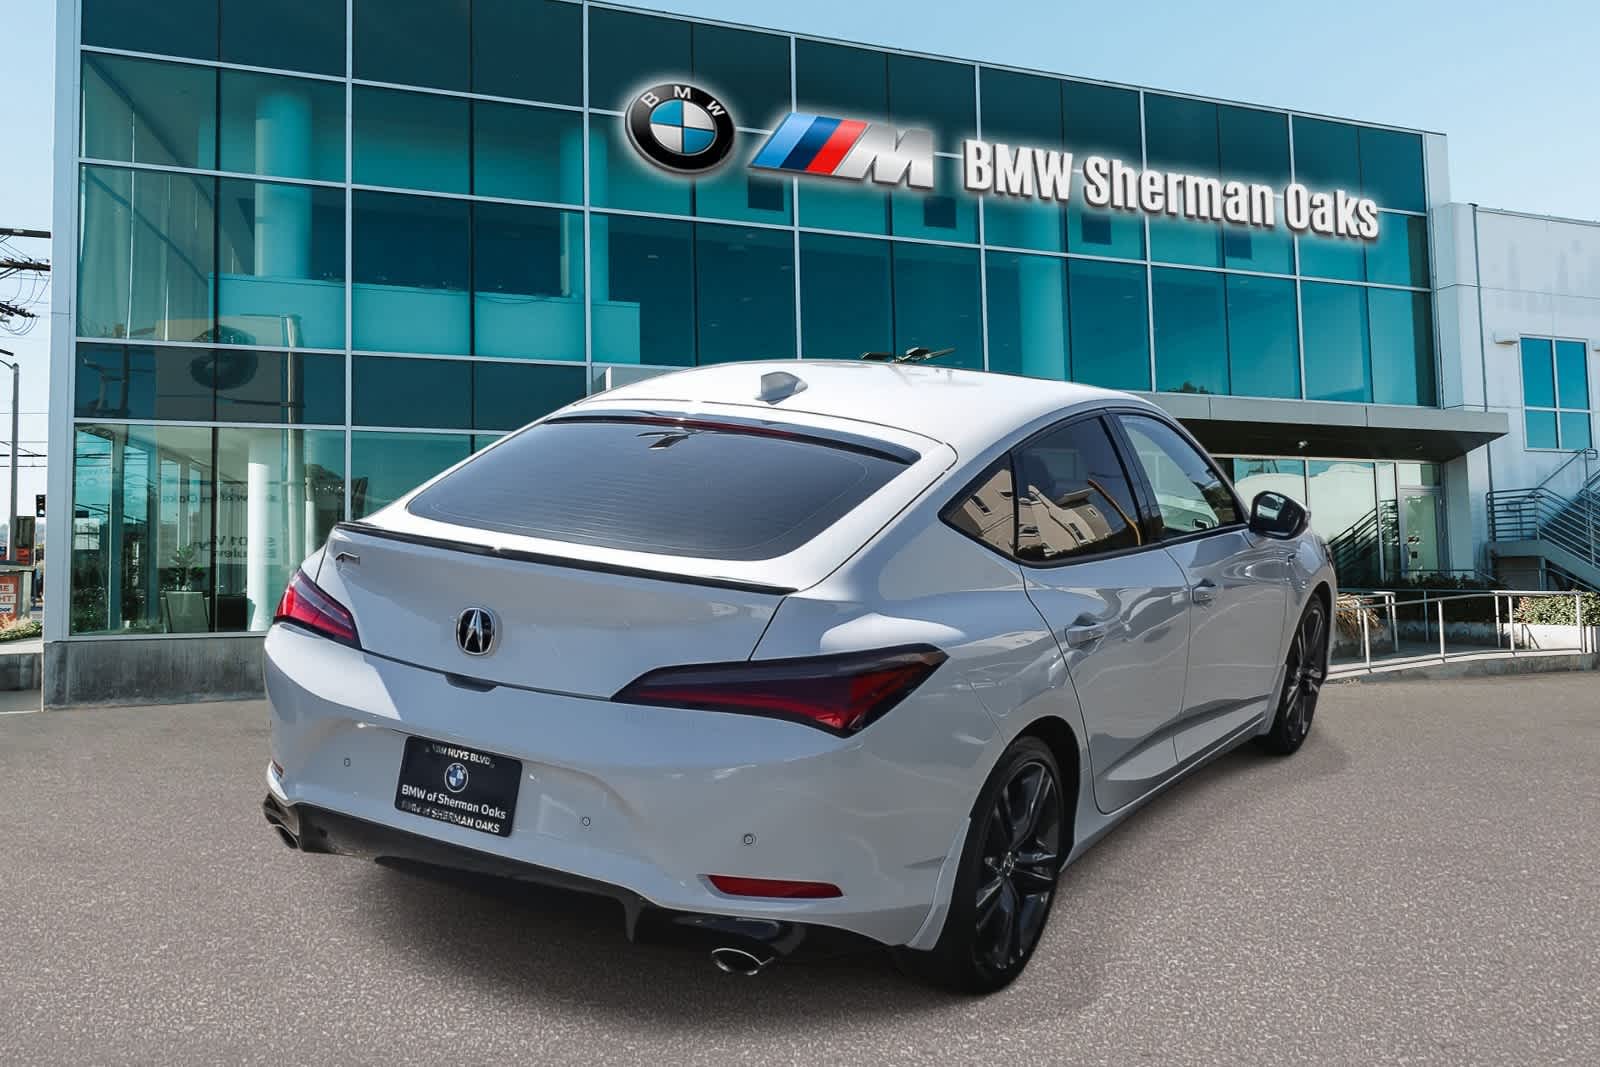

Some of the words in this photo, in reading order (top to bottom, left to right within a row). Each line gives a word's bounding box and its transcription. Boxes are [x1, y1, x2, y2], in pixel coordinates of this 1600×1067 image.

[641, 85, 725, 118] BMW
[963, 138, 1073, 204] BMW
[1083, 155, 1276, 228] Sherman
[1284, 183, 1379, 241] Oaks
[447, 747, 469, 760] NUYS
[470, 752, 492, 765] BLVD
[401, 784, 426, 800] BMW
[427, 792, 437, 802] of
[438, 793, 479, 813] Sherman
[481, 805, 506, 820] Oaks
[475, 818, 500, 833] OAKS
